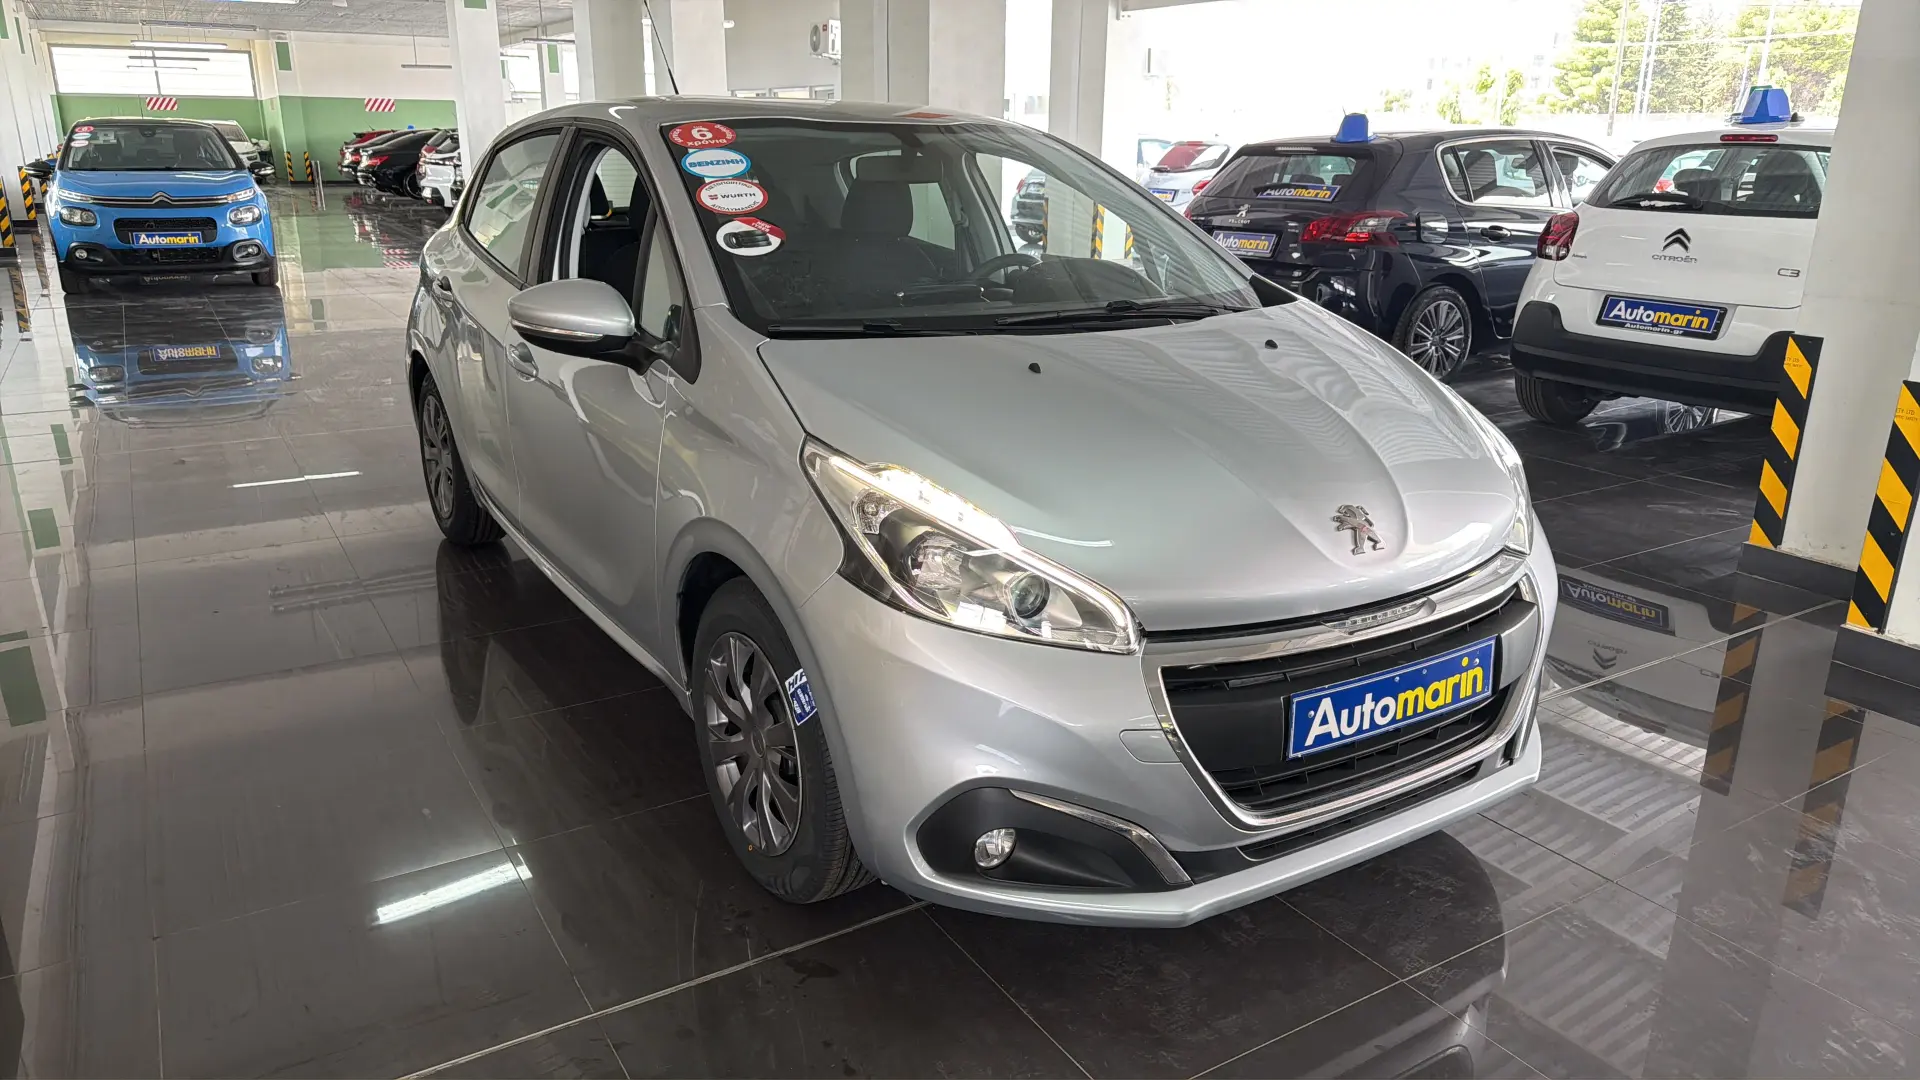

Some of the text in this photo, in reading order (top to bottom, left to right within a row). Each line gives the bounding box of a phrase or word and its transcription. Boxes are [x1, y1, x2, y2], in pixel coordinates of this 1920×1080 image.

[691, 127, 713, 140] 6
[686, 138, 727, 147] χρόνια
[139, 232, 199, 245] Automarin
[1216, 232, 1269, 250] Automarin
[1777, 267, 1801, 278] C3
[1609, 301, 1709, 331] Automarin
[1624, 322, 1685, 336] Automarin.gr
[1304, 656, 1484, 747] Automarin
